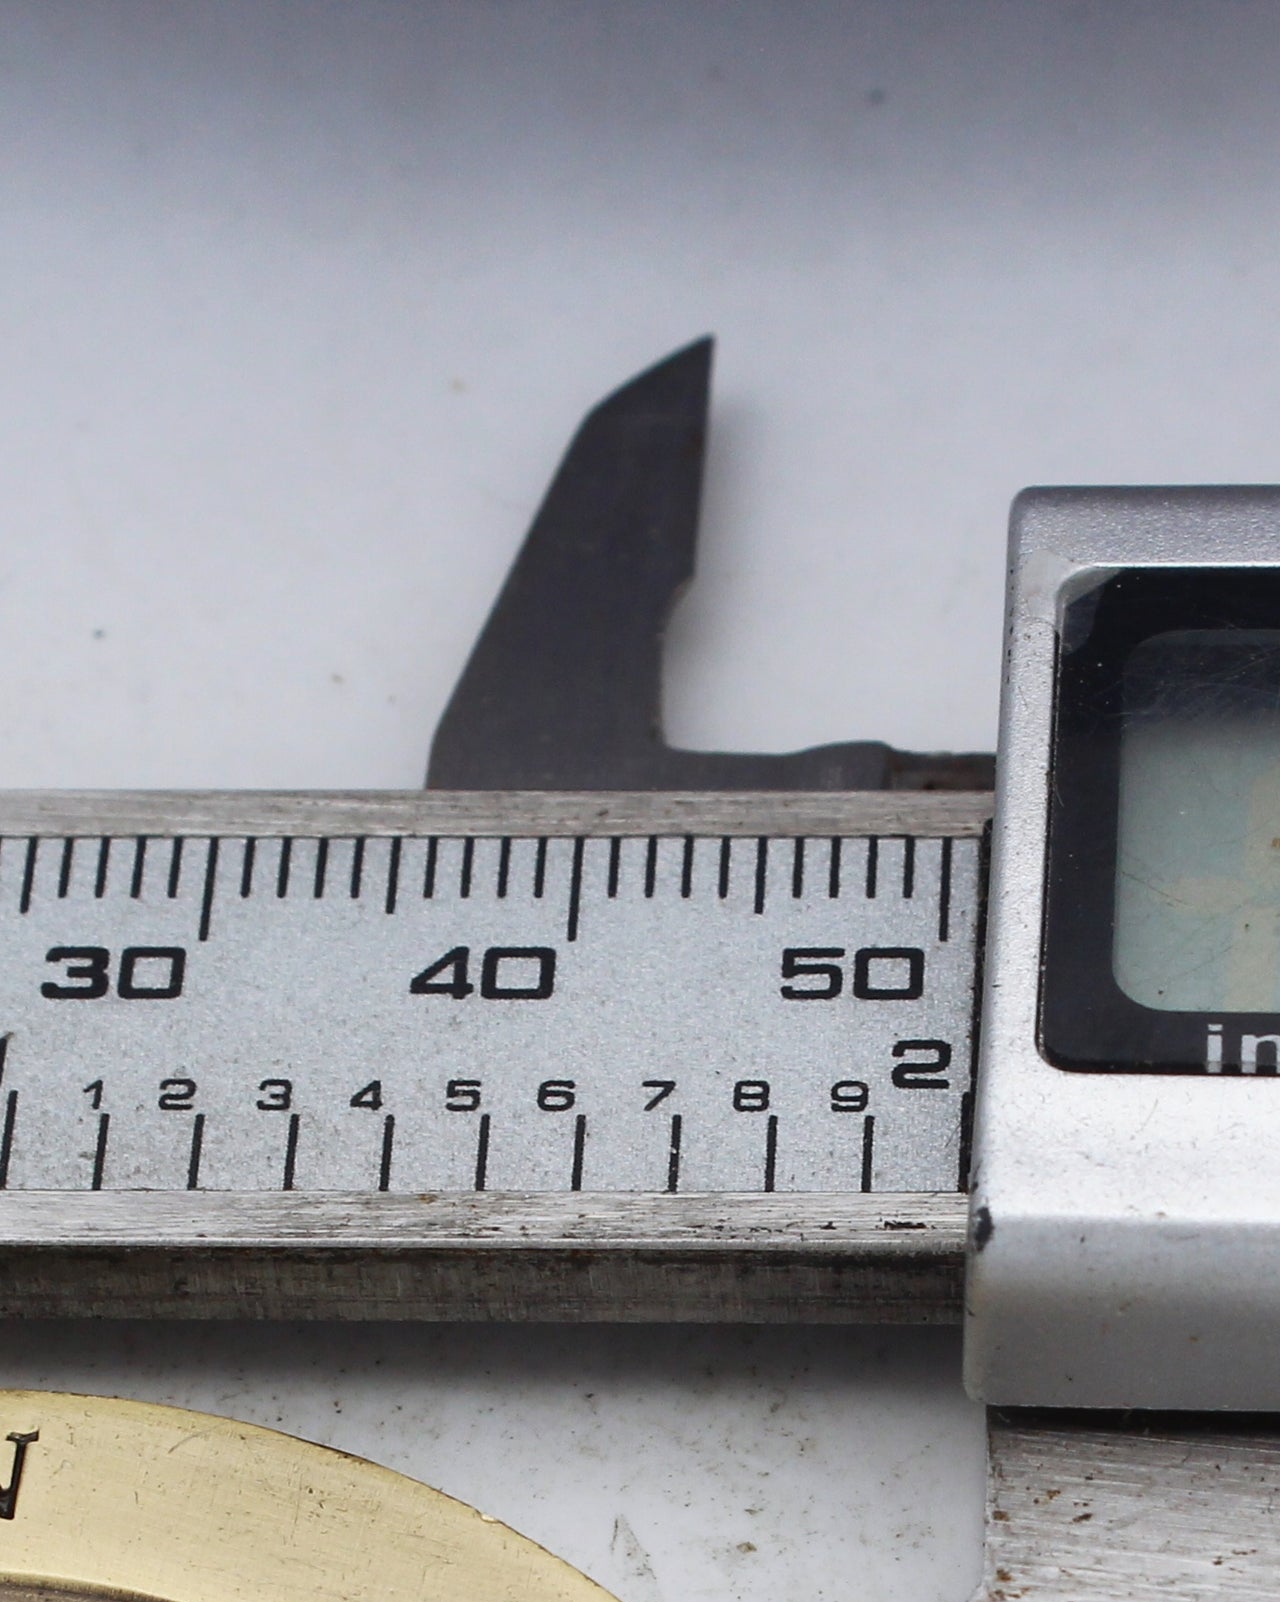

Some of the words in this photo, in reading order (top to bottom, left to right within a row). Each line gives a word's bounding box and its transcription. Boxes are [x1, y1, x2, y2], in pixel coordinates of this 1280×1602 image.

[39, 944, 188, 1002] 30
[408, 944, 558, 1002] 40
[778, 945, 927, 1003] 50
[81, 1078, 105, 1112] 1
[157, 1077, 199, 1113] 2
[254, 1077, 294, 1113] 3
[348, 1078, 385, 1113] 4
[443, 1078, 483, 1114] 5
[535, 1078, 578, 1114] 6
[640, 1078, 678, 1113] 7
[731, 1078, 772, 1114] 8
[829, 1078, 871, 1114] 9
[889, 1037, 954, 1091] 2
